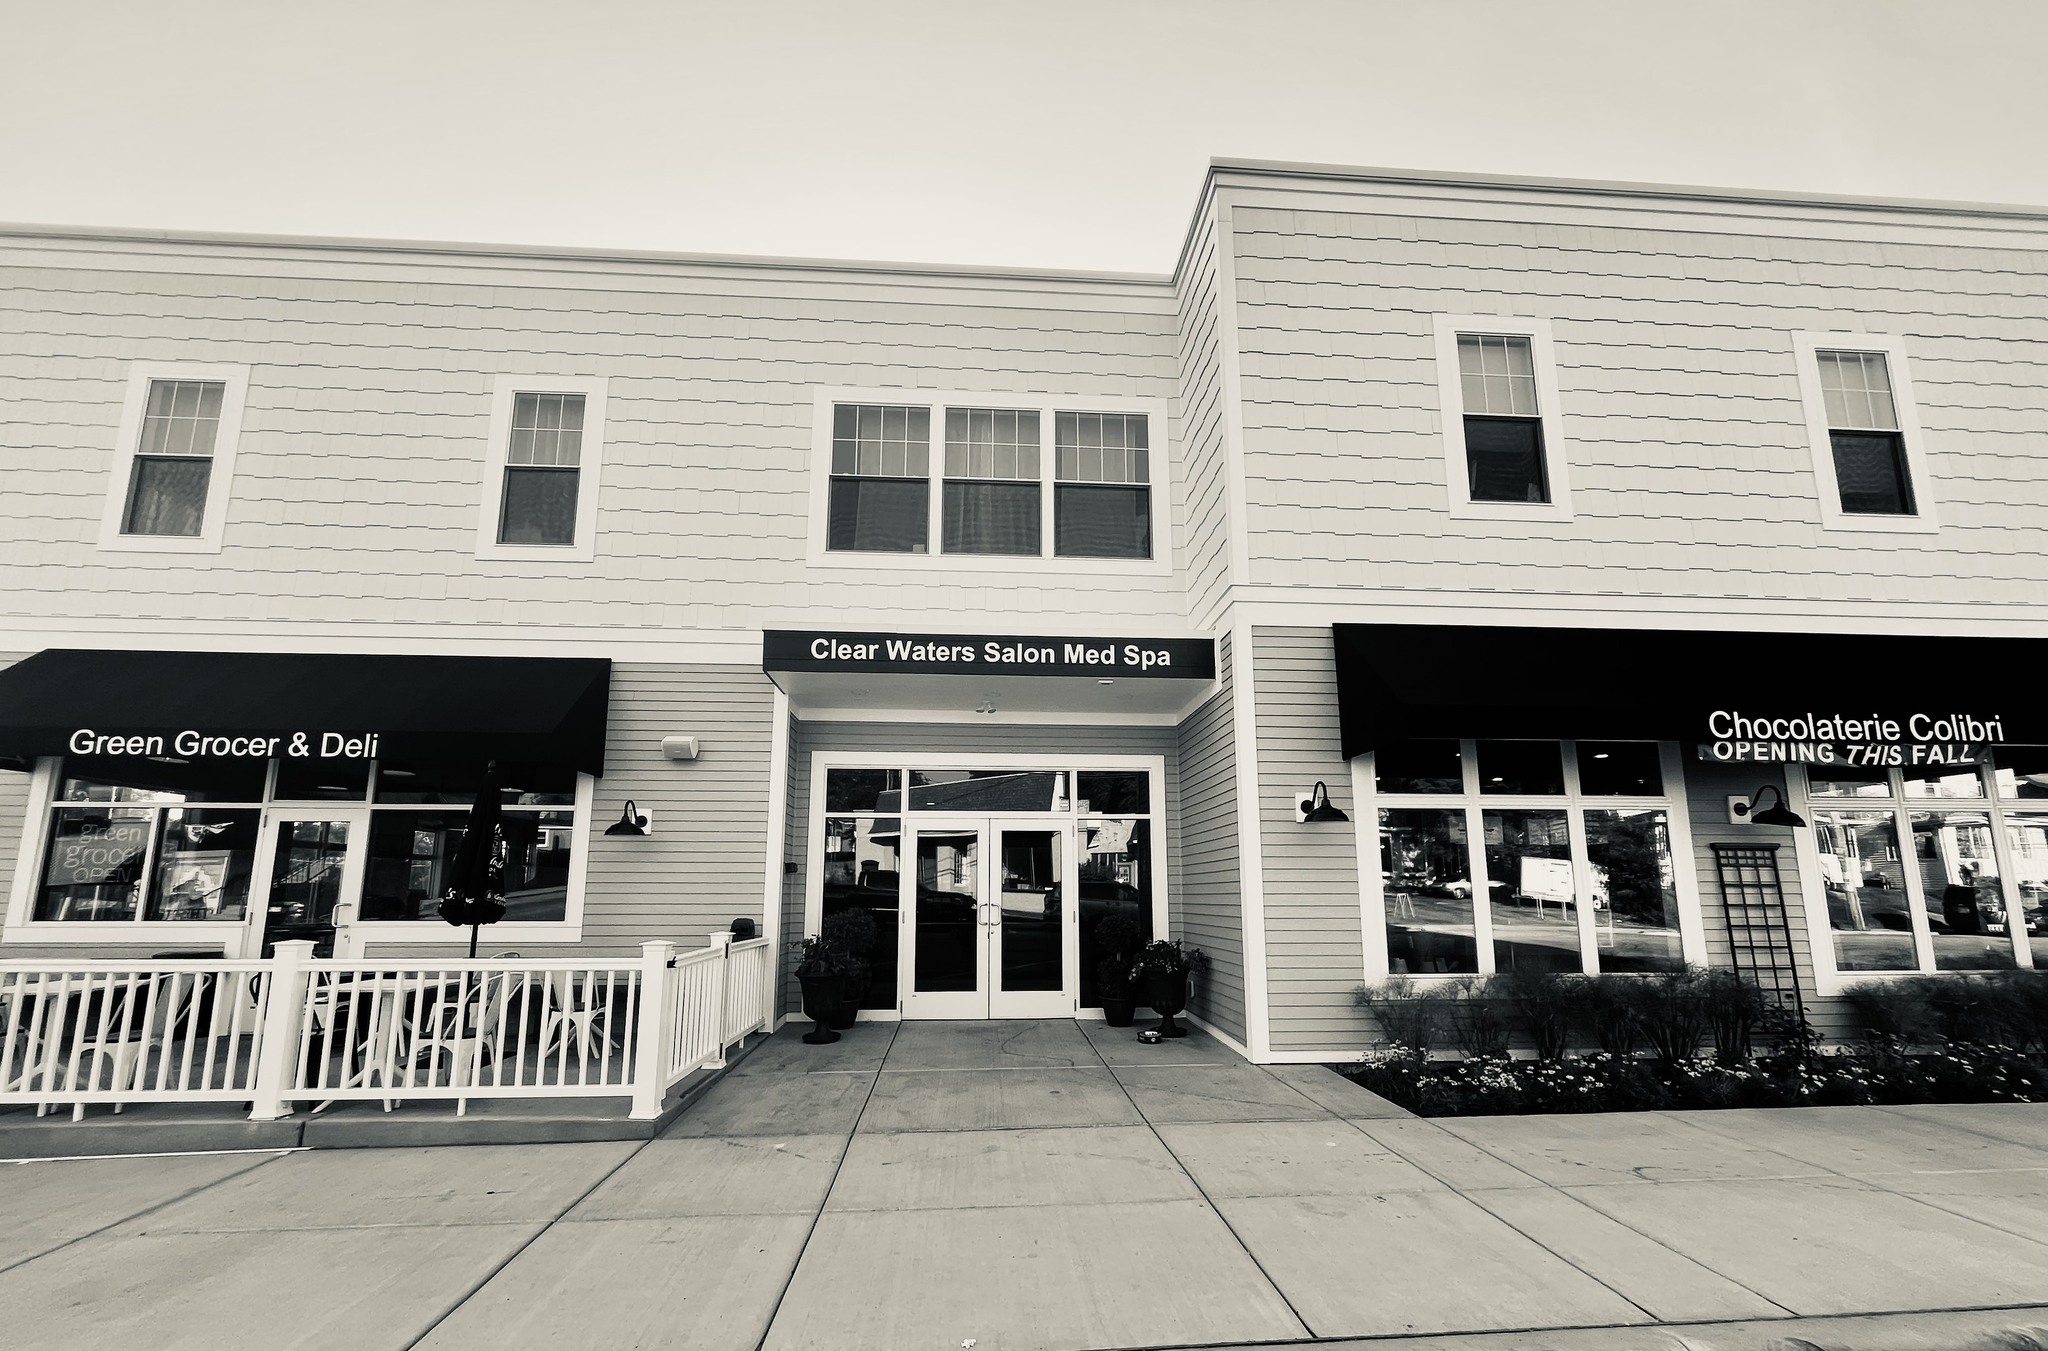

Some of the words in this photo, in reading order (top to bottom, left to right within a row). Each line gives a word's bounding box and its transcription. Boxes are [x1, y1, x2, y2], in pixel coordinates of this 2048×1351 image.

[810, 638, 879, 660] Clear
[886, 640, 976, 663] Waters
[983, 643, 1055, 664] Salon
[1064, 643, 1116, 665] Med
[1123, 645, 1171, 671] Spa
[1708, 710, 1901, 741] Chocolaterie
[1909, 713, 2004, 742] Colibri
[69, 728, 164, 756] Green
[174, 730, 281, 758] Grocer
[287, 731, 310, 758] &
[320, 732, 379, 759] Deli
[1712, 741, 1835, 764] OPENING
[1846, 743, 1903, 766] THIS
[1912, 744, 1975, 765] FALL
[79, 823, 142, 844] green
[72, 867, 133, 883] OPEN
